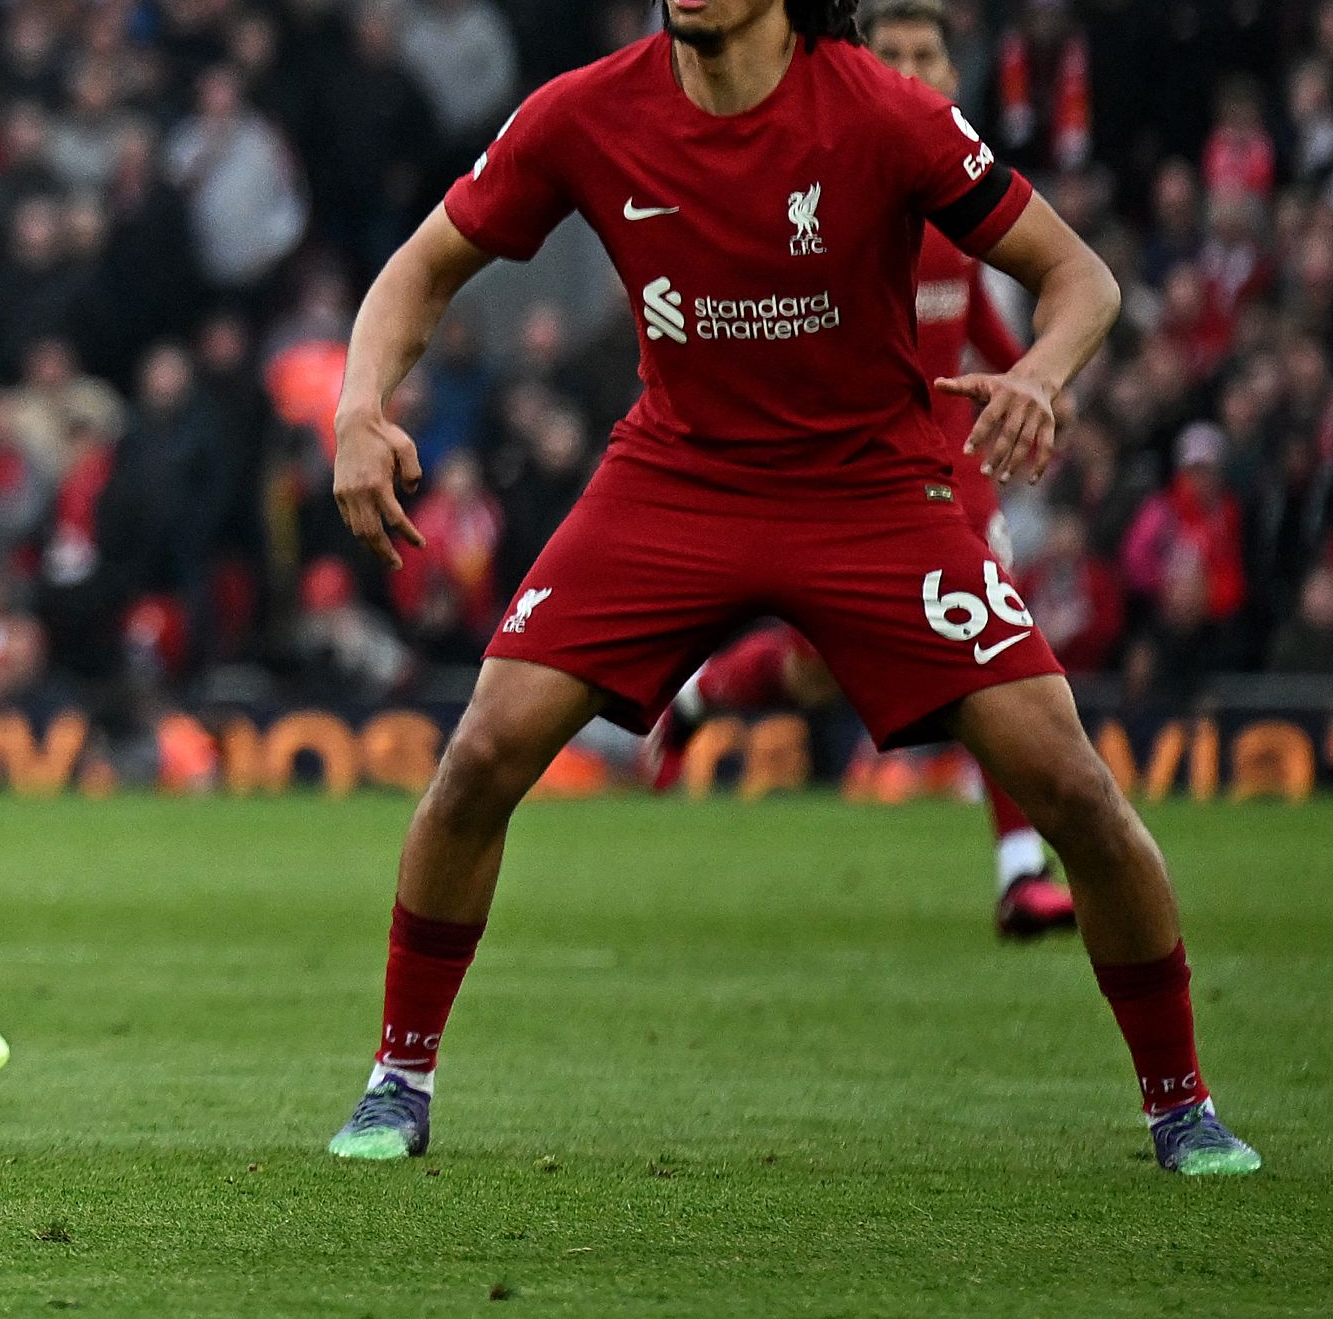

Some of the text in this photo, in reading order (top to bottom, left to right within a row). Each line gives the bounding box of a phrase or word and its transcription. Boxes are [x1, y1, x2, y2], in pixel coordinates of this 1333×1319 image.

[694, 290, 830, 319] standard
[696, 306, 841, 341] chartered
[922, 559, 1034, 642] 66
